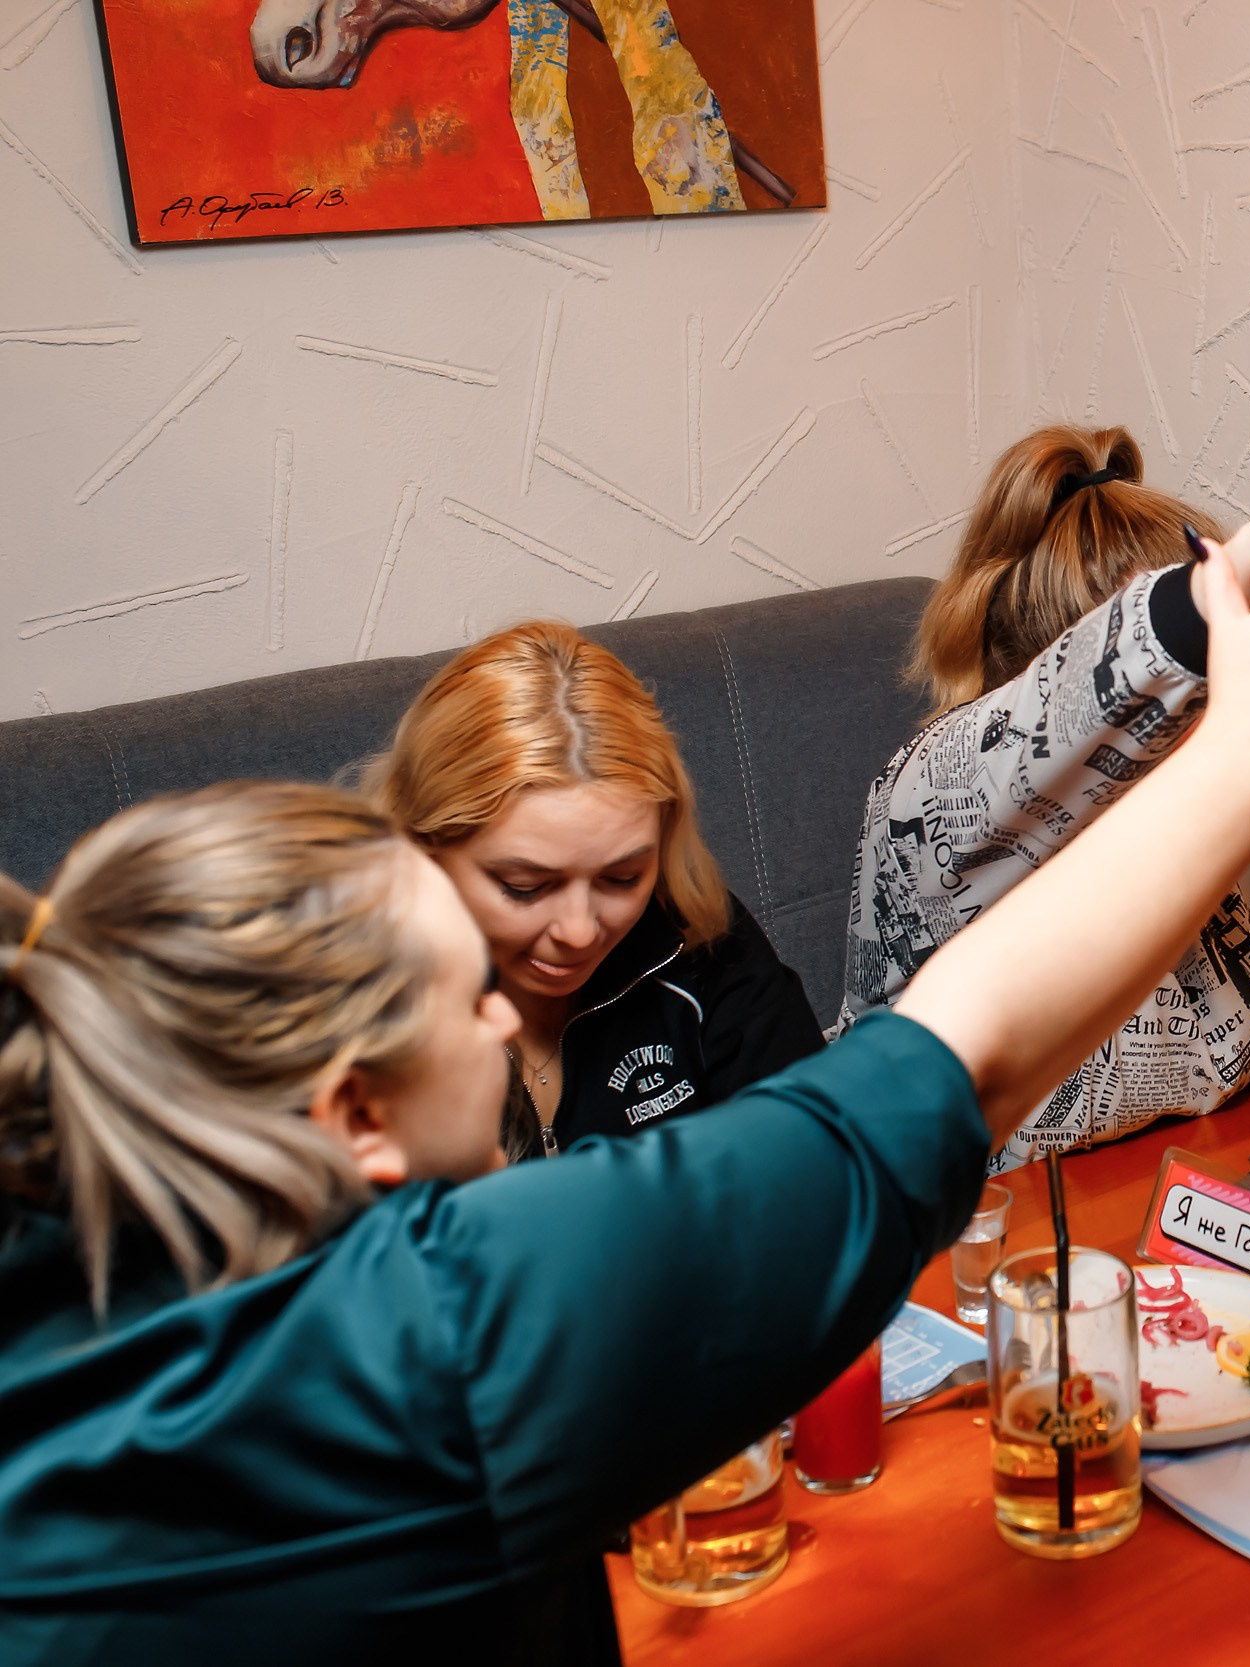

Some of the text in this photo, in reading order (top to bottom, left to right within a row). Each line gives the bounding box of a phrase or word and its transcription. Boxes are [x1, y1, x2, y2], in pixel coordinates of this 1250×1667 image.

[1018, 764, 1075, 824] leeping
[1009, 782, 1067, 836] CAUSES
[1016, 843, 1040, 863] YOUR
[1122, 1014, 1163, 1036] And
[1092, 1062, 1107, 1085] TIPS
[1105, 1065, 1121, 1090] TIPS
[1173, 1195, 1193, 1226] Я
[1197, 1217, 1227, 1243] же
